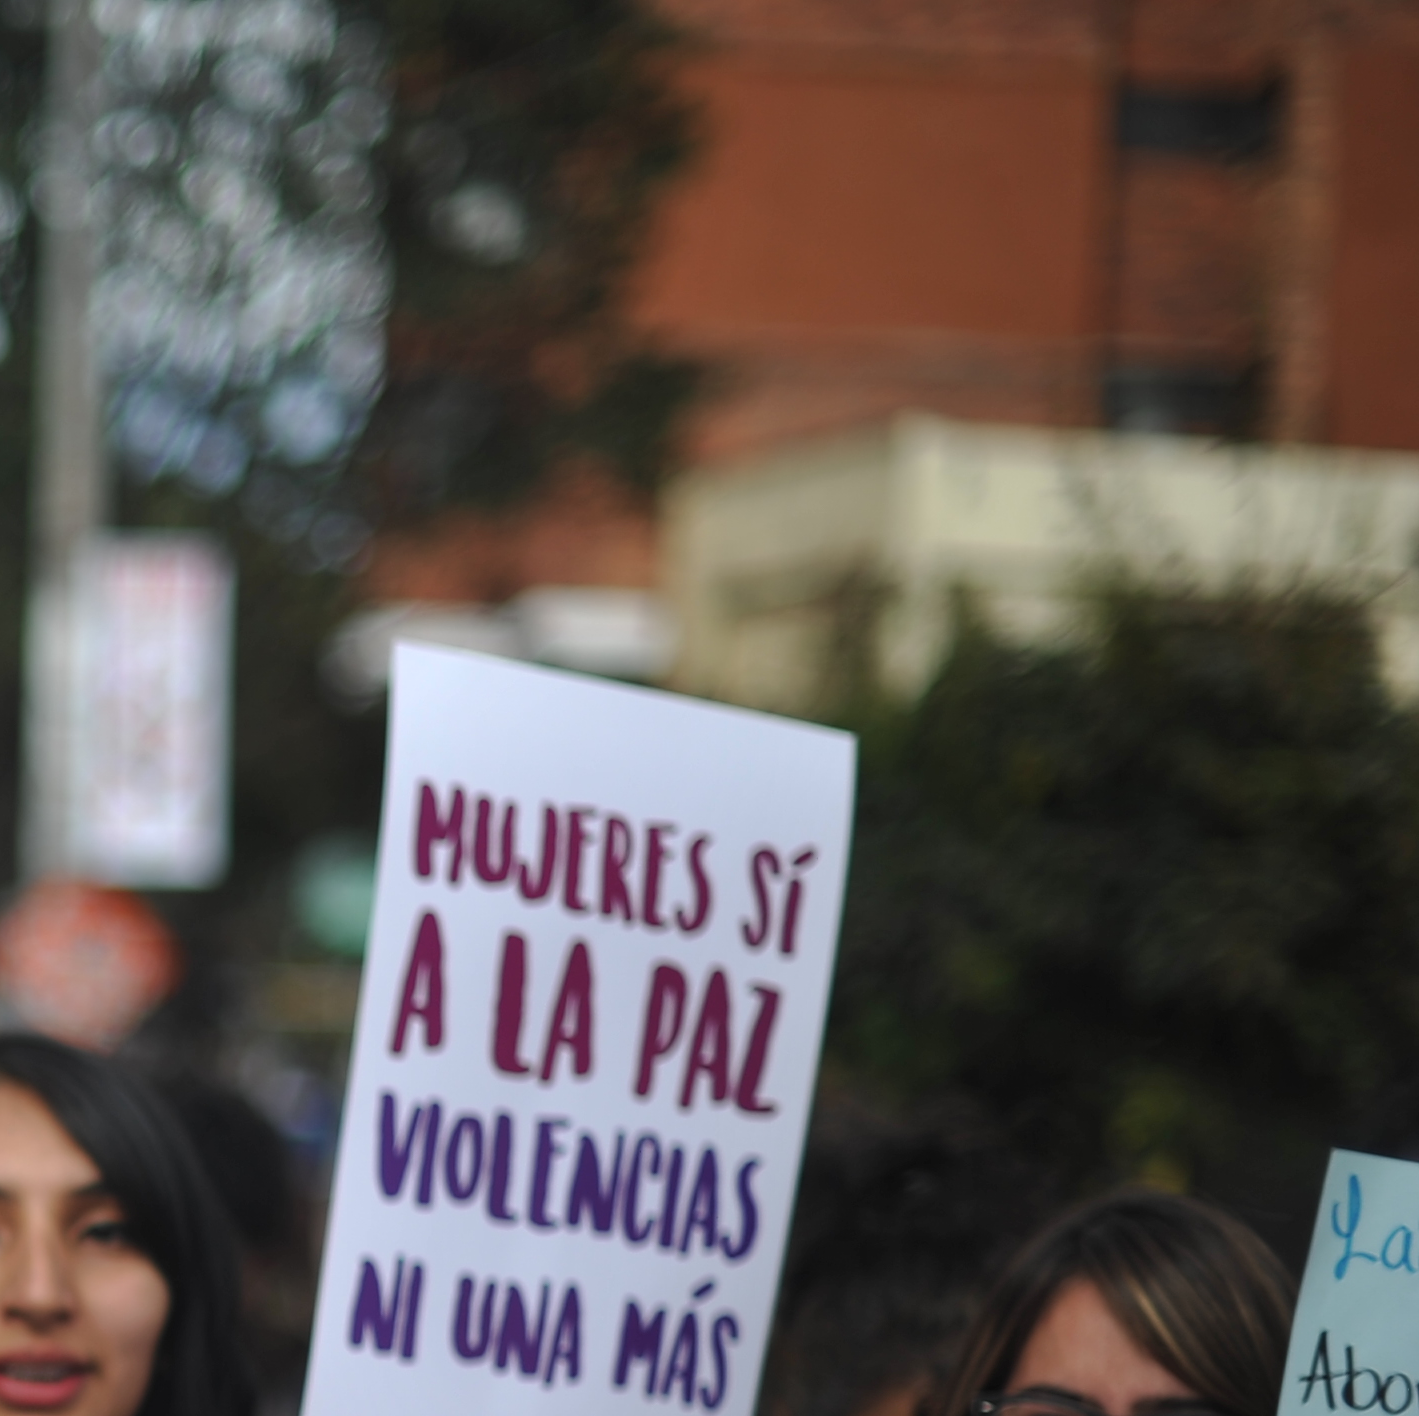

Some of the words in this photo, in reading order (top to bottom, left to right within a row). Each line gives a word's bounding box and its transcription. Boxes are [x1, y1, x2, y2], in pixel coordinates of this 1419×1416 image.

[413, 779, 711, 934] MUJERES
[741, 846, 816, 957] SÍ
[389, 909, 446, 1057] A
[491, 931, 594, 1085] LA
[633, 962, 782, 1117] PAZ
[377, 1090, 763, 1261] VIOLENCIAS
[349, 1257, 425, 1362] NI
[451, 1275, 582, 1387] UNA
[613, 1281, 739, 1413] MÁS
[1298, 1331, 1419, 1416] Abo
